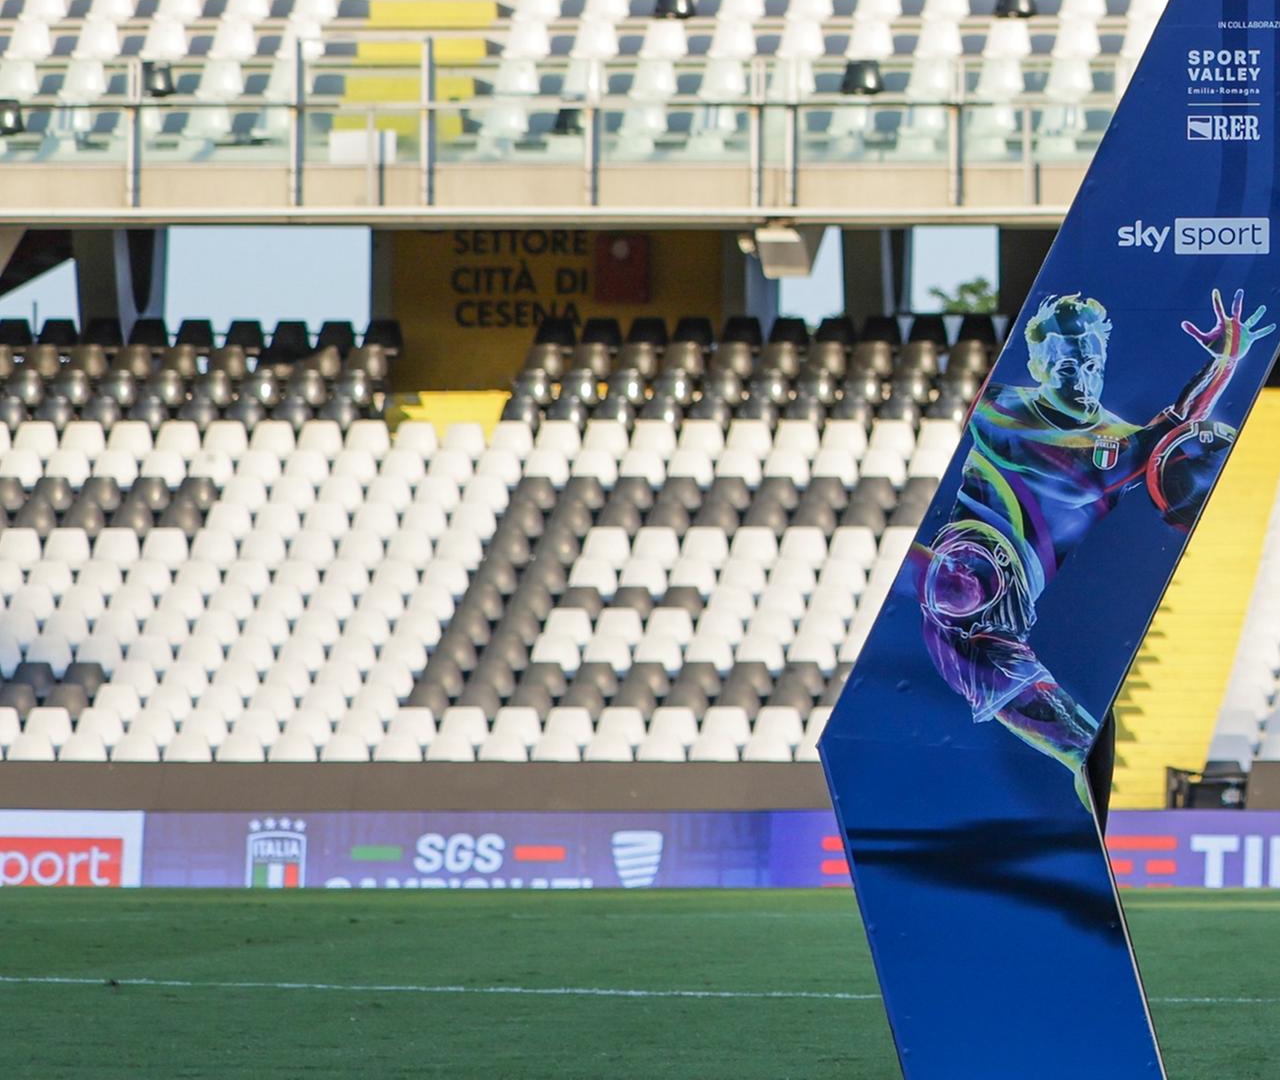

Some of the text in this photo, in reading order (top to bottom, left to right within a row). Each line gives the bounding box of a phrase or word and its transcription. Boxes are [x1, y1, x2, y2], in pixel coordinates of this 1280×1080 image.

[1218, 21, 1226, 29] IN
[1188, 50, 1261, 65] SPORT
[1188, 68, 1261, 81] VALLEY
[1188, 87, 1260, 96] Emilia-Romagna
[454, 230, 588, 255] SETTORE
[1117, 220, 1262, 253] sky sport
[452, 260, 588, 296] CITTÀ DI
[455, 300, 583, 328] CESENA
[250, 839, 300, 857] ITALIA
[413, 832, 506, 874] SGS
